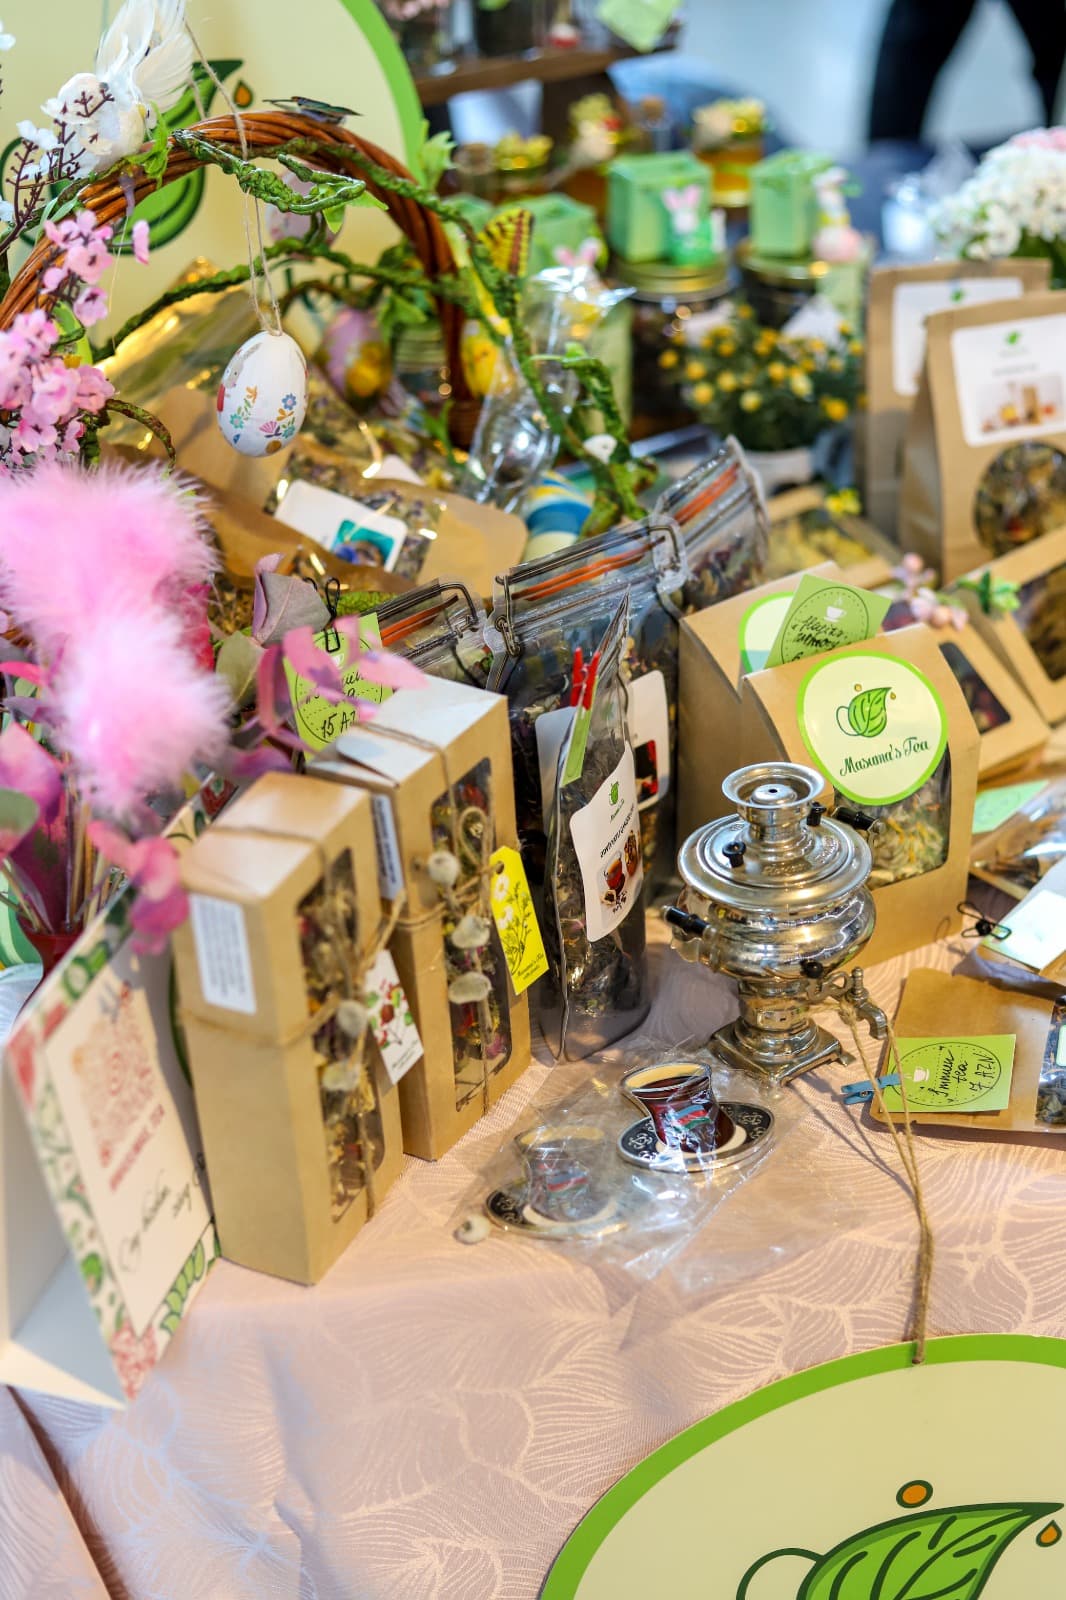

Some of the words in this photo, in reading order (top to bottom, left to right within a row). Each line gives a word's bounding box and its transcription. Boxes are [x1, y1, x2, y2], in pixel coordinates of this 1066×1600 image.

[839, 744, 901, 776] Masuma's
[902, 736, 929, 757] Tea
[973, 1052, 995, 1079] AZN
